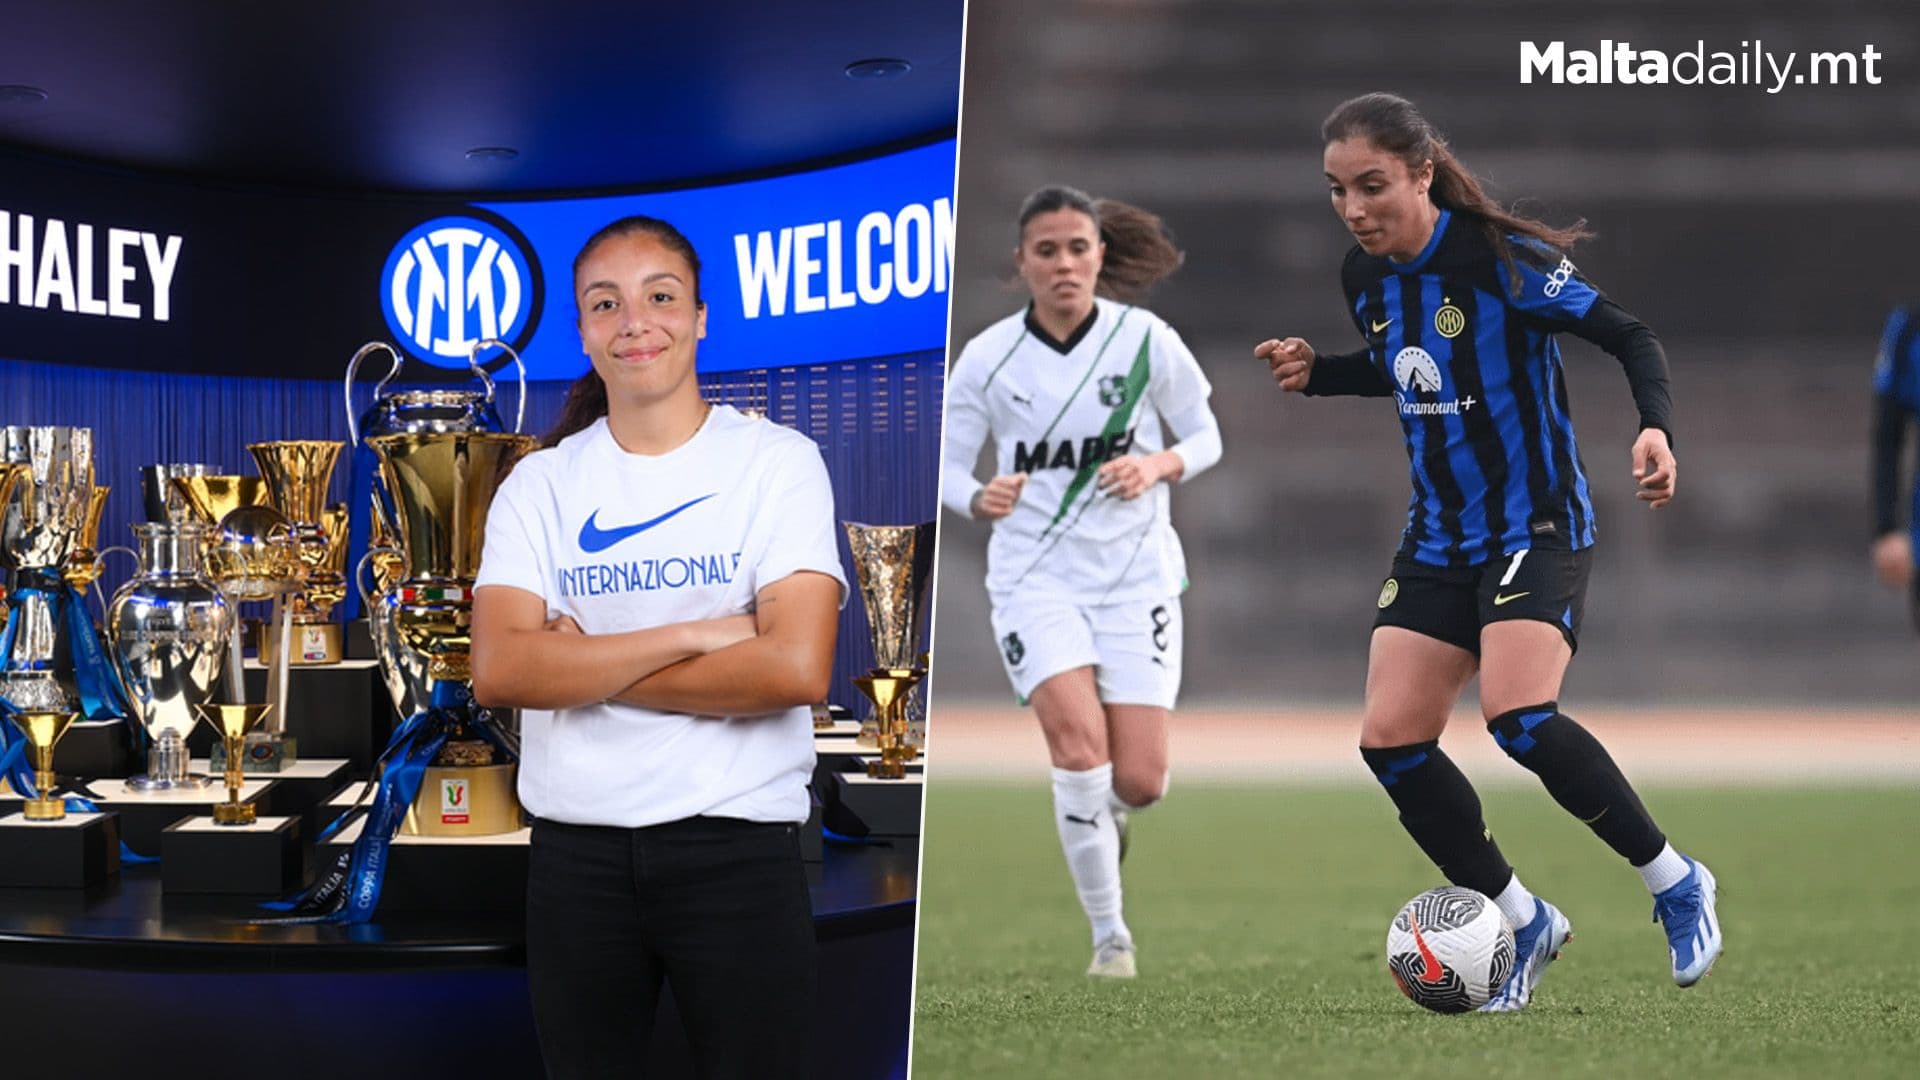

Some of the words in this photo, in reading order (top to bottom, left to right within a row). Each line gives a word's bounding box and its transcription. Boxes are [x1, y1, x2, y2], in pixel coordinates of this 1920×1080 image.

[0, 210, 183, 321] HALEY
[1543, 254, 1580, 298] eba
[1393, 389, 1476, 416] Paramount+
[1500, 548, 1531, 586] 7
[1150, 604, 1171, 653] 8
